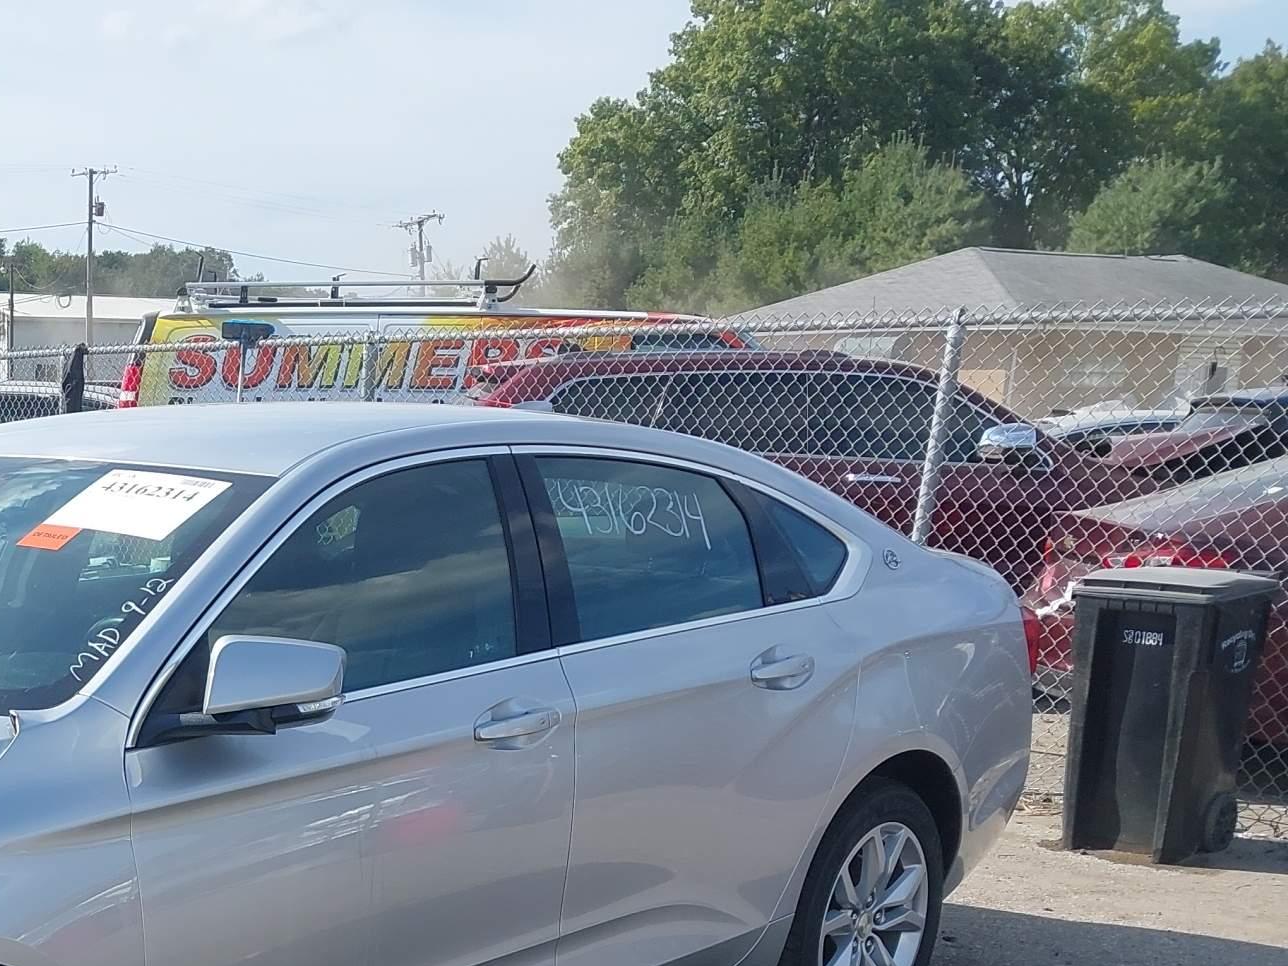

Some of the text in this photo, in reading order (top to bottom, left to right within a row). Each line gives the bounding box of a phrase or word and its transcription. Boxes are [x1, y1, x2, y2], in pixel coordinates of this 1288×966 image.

[101, 481, 200, 502] 43162314
[556, 482, 712, 551] 43162314
[69, 578, 175, 682] MAD 9-12
